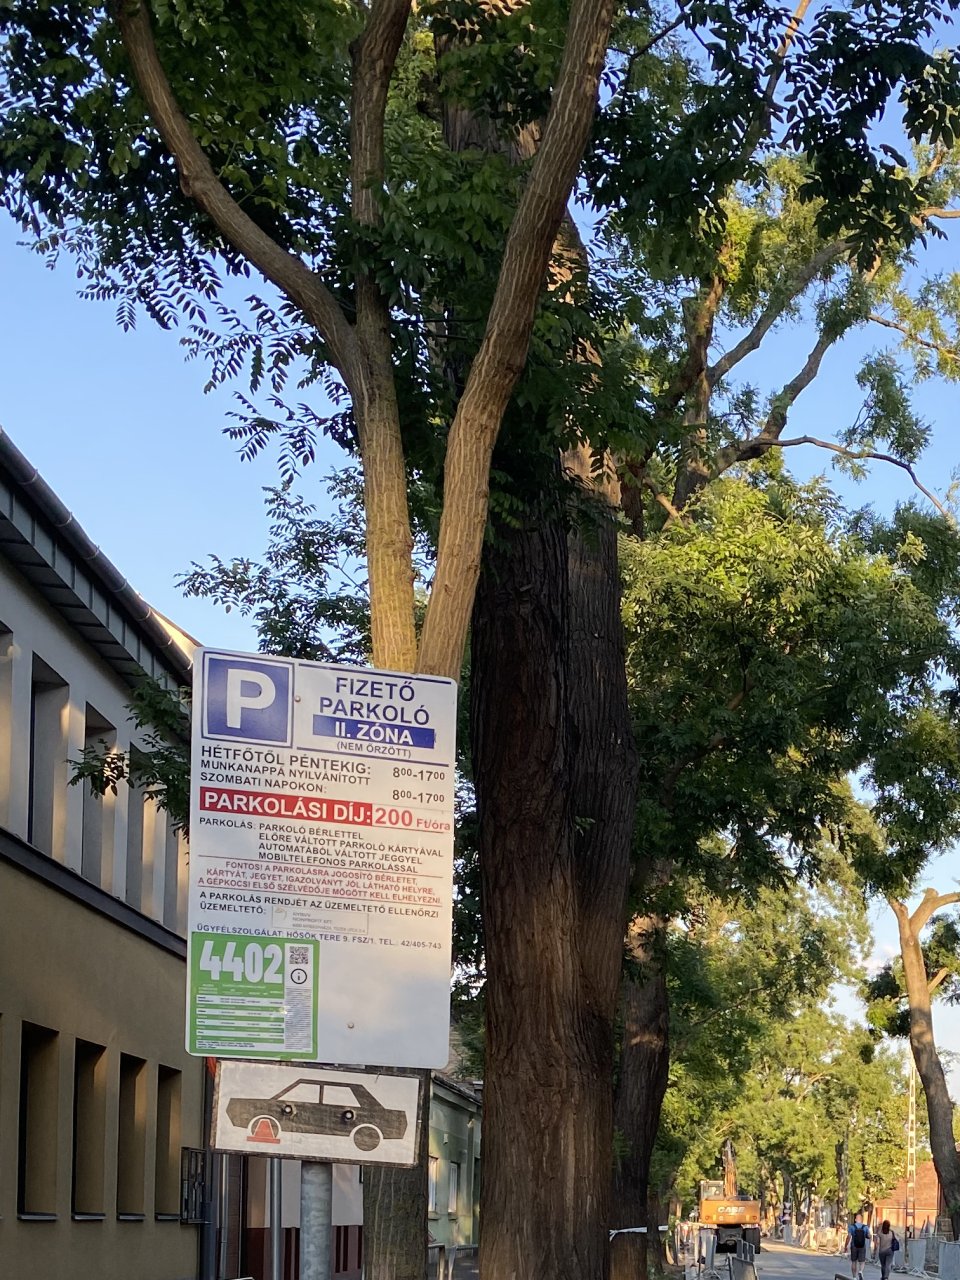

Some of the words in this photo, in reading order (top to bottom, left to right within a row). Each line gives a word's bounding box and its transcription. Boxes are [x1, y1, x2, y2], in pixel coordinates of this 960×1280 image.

[336, 677, 415, 701] FIZETŐ
[320, 697, 429, 725] PARKOLÓ
[335, 721, 350, 737] II.
[356, 722, 413, 745] ZÓNA
[201, 744, 284, 765] HÉTFŐTŐL
[290, 753, 371, 774] PÉNTEKIG:
[337, 742, 363, 751] (NEM
[366, 743, 411, 758] ŐRZÖTT)
[200, 772, 261, 786] SZOMBATI
[264, 779, 328, 793] NAPOKON:
[201, 760, 285, 776] MUNKANAPPÁ
[289, 768, 371, 786] NYILVÁNÍTOTT
[204, 791, 327, 819] PARKOLÁSI
[333, 802, 371, 823] DÍJ:
[375, 807, 413, 827] 200
[416, 818, 450, 831] Ft/óra
[199, 816, 256, 830] PARKOLÁS:
[259, 823, 306, 835] PARKOLÓ
[309, 827, 364, 840] BÉRLETTEL
[258, 842, 332, 856] AUTOMATÁBÓL
[334, 848, 377, 860] VÁLTOTT
[379, 854, 423, 865] JEGGYEL
[259, 832, 291, 842] ELŐRE
[294, 835, 337, 847] VÁLTOTT
[340, 840, 385, 852] PARKOLÓ
[388, 844, 444, 857] KÁRTYÁVAL
[225, 861, 262, 871] FONTOS!
[272, 864, 329, 877] PARKOLÁSRA
[331, 869, 373, 880] JOGOSÍTÓ
[258, 852, 346, 866] MOBILTELEFONOS
[349, 860, 418, 873] PARKOLÁSSAL
[206, 877, 250, 888] GÉPKOCSI
[252, 881, 275, 890] ELSŐ
[277, 883, 332, 895] SZÉLVÉDŐJE
[332, 887, 368, 898] MÖGÖTT
[369, 891, 390, 900] KELL
[286, 876, 343, 887] IGAZOLVÁNYT
[345, 879, 361, 888] JÓL
[362, 881, 400, 892] LÁTHATÓ
[199, 891, 207, 899] A
[209, 892, 262, 903] PARKOLÁS
[264, 896, 308, 907] RENDJÉT
[310, 900, 322, 909] AZ
[325, 901, 386, 914] ÜZEMELTETŐ
[388, 907, 439, 918] ELLENŐRZI
[200, 901, 266, 915] ÜZEMELTETŐ:
[319, 934, 341, 942] TERE
[400, 940, 442, 949] 42/405-743
[200, 941, 283, 984] 4402
